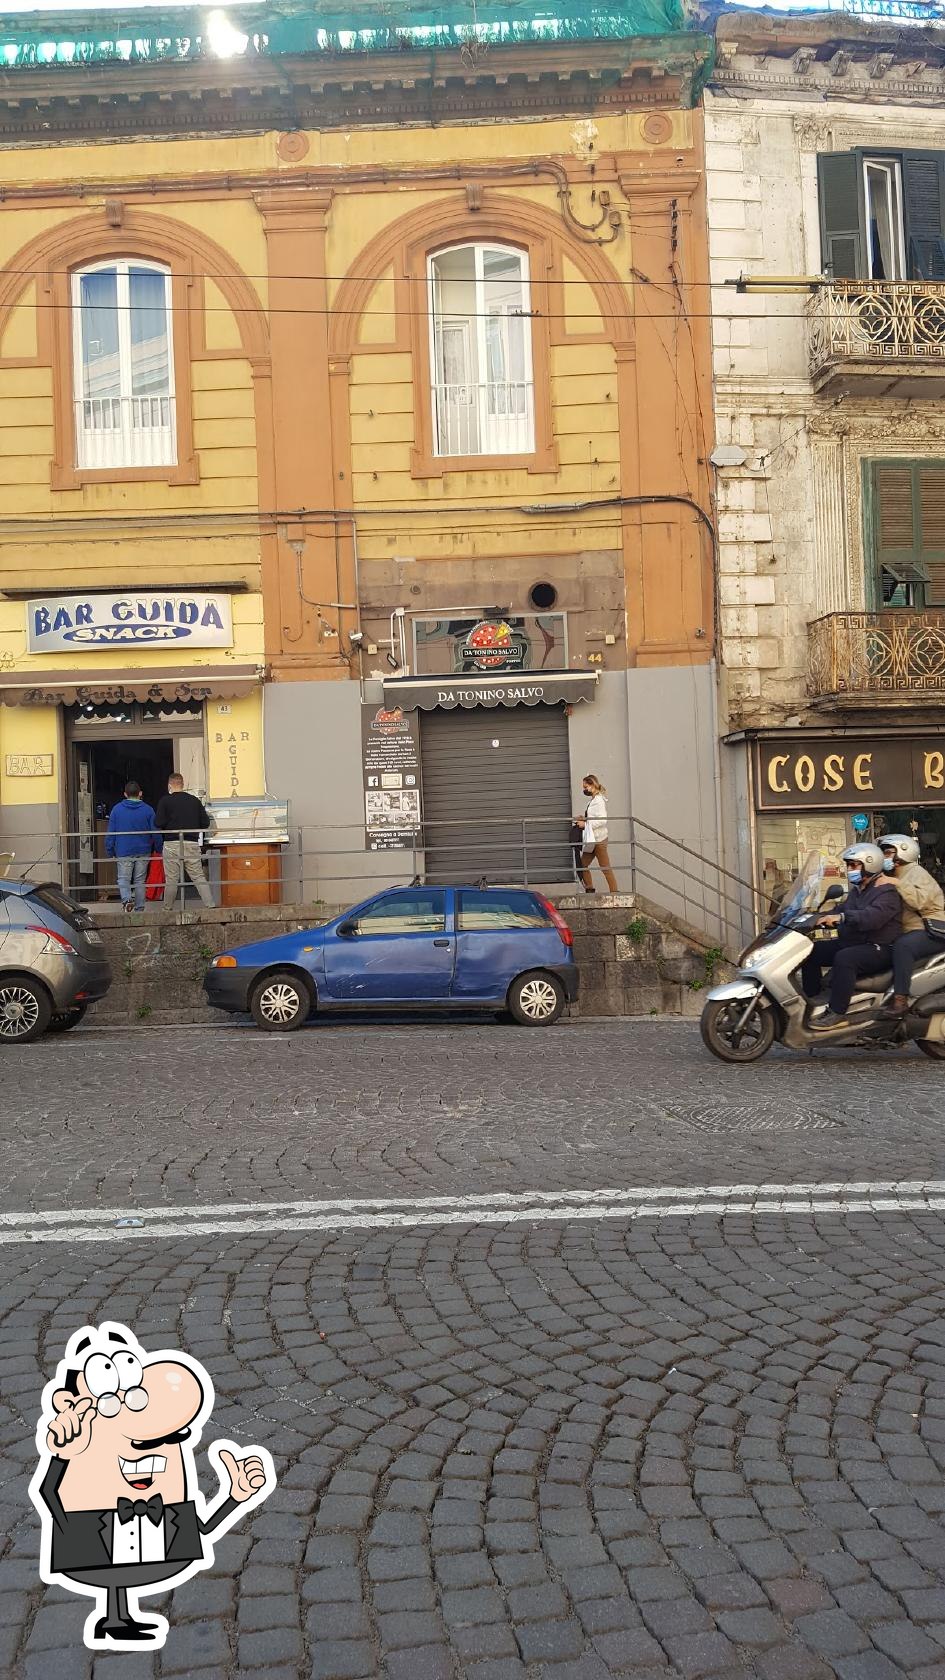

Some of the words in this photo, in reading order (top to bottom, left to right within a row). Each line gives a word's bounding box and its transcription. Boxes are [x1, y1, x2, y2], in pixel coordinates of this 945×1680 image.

[34, 602, 94, 637] BAR
[111, 598, 225, 630] GUIDA
[72, 625, 178, 642] SNACK
[587, 654, 603, 663] 44
[76, 685, 136, 703] Guida
[147, 684, 162, 697] &
[437, 691, 455, 702] DA
[456, 689, 505, 702] TONINO
[507, 687, 544, 700] SALVO
[215, 731, 250, 743] BAR
[9, 756, 46, 774] BAR
[227, 745, 240, 798] GUIDA
[767, 753, 874, 793] COSE
